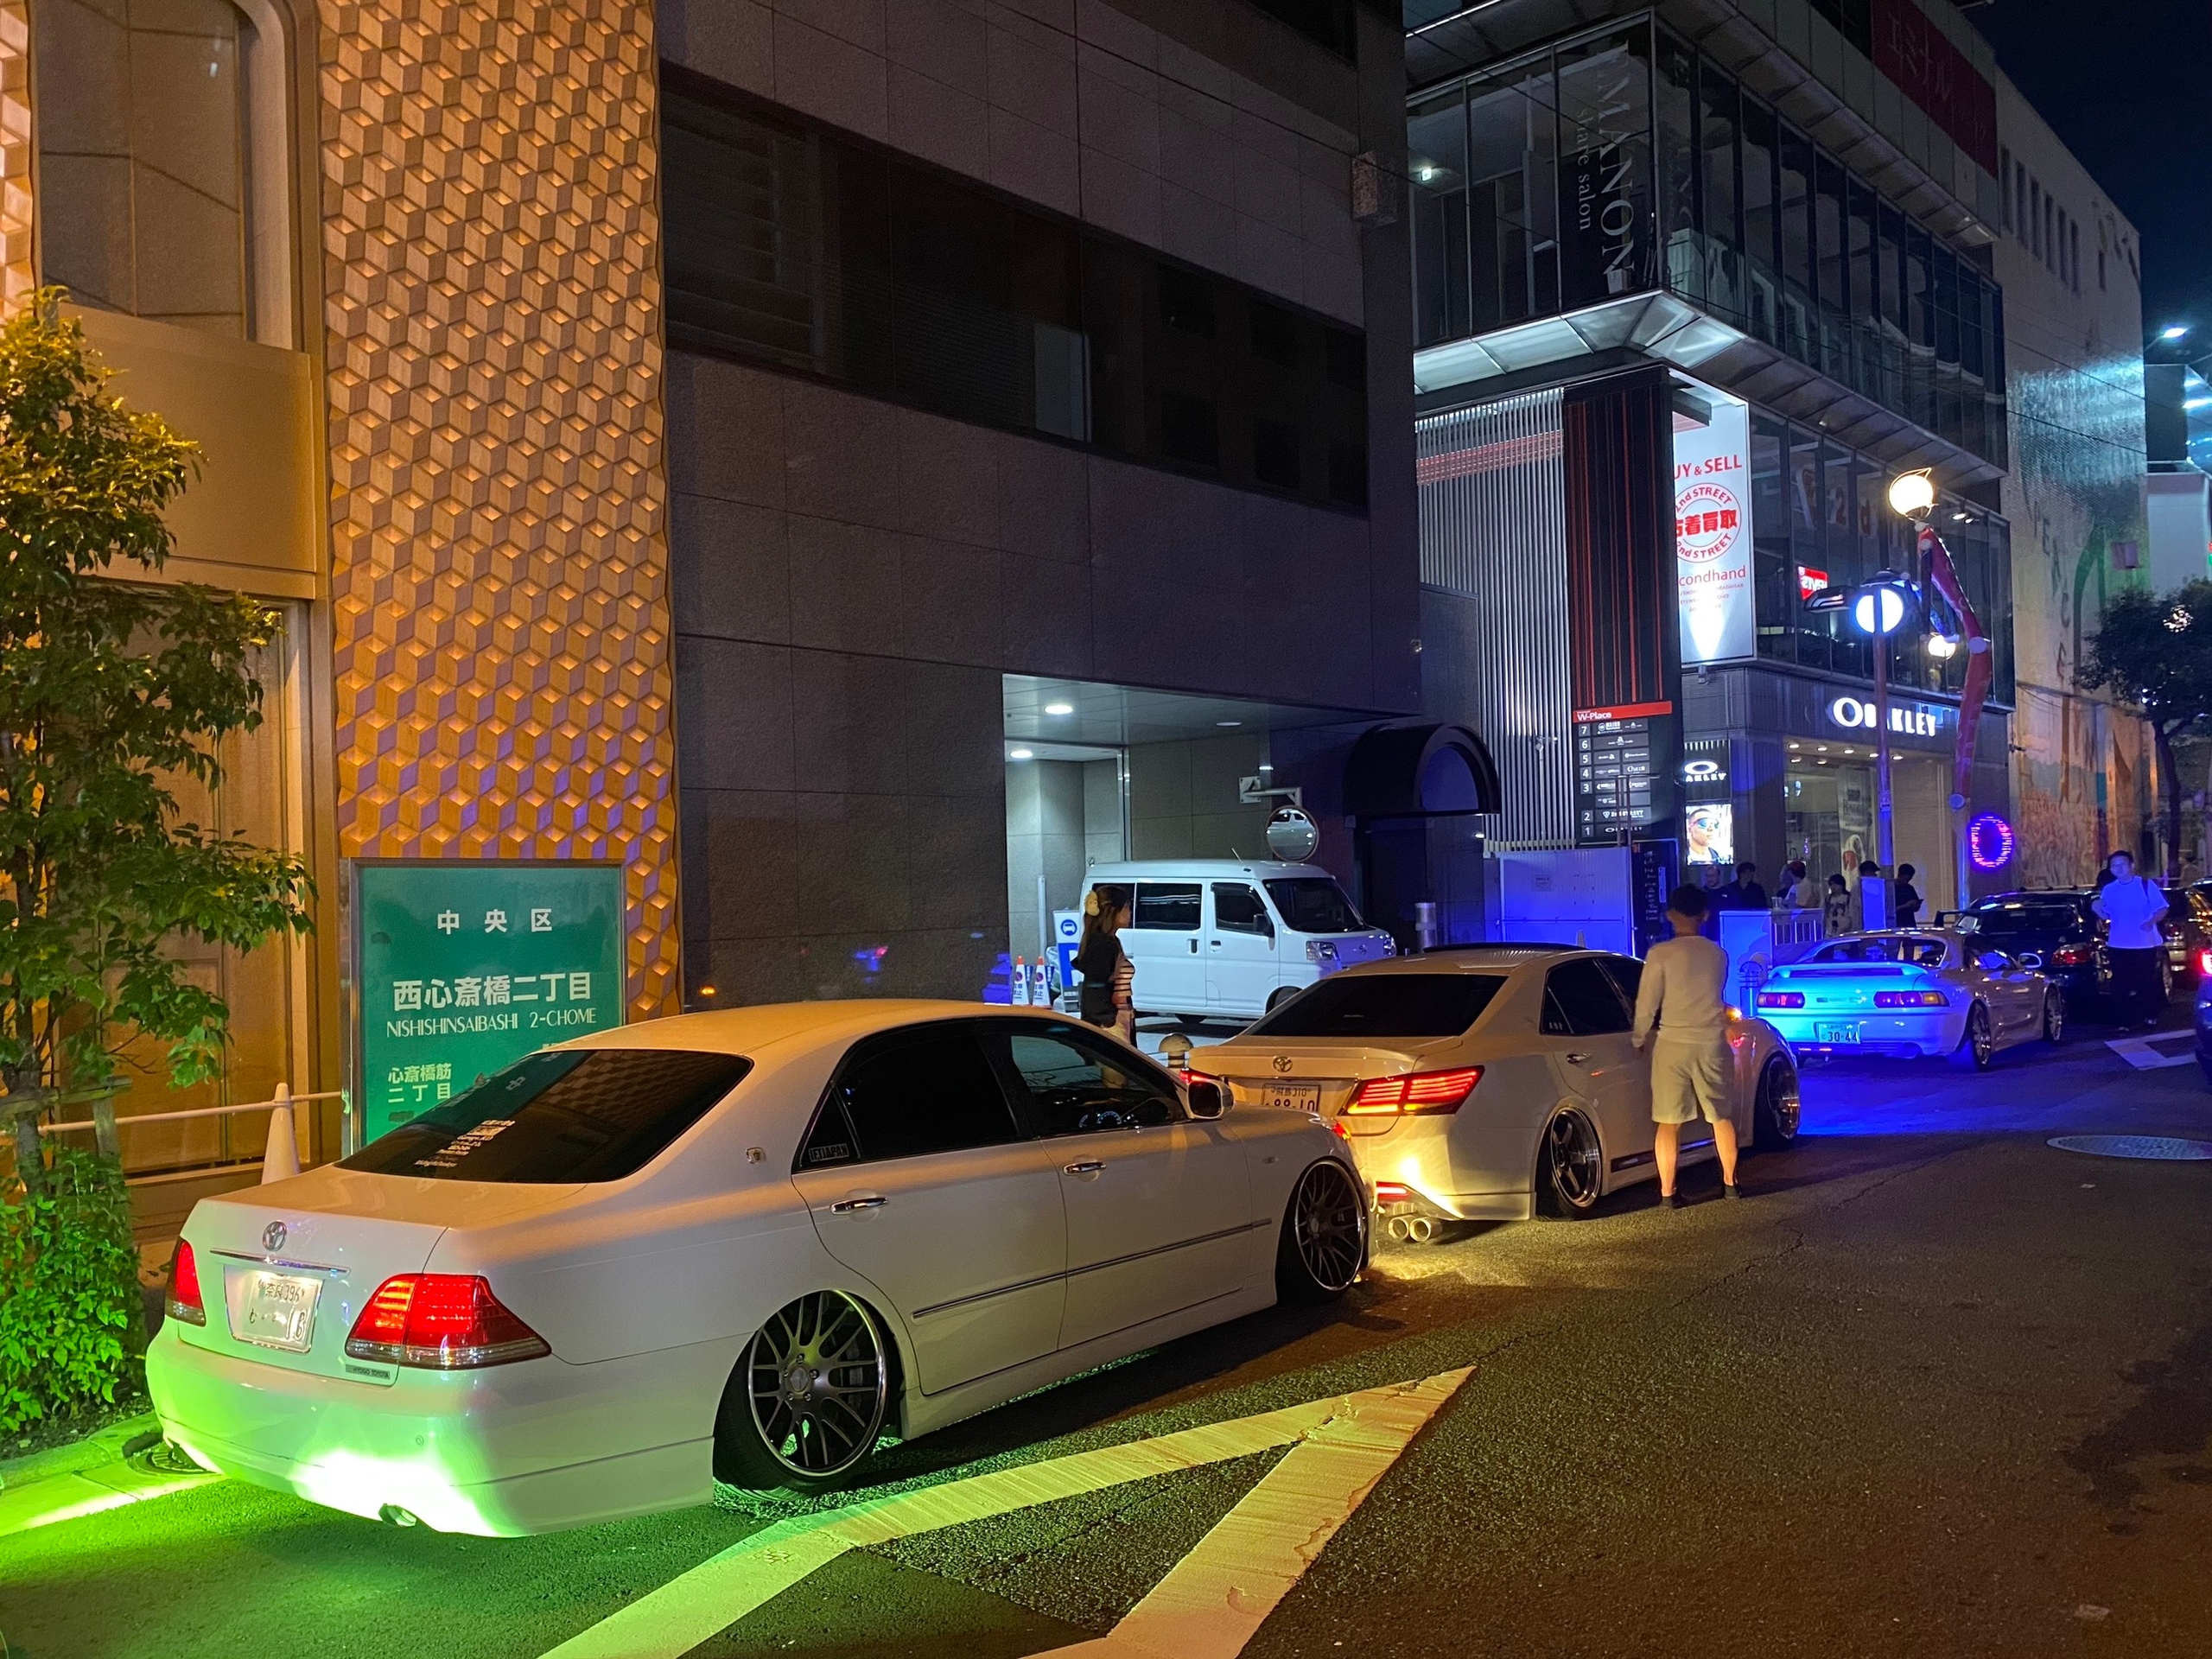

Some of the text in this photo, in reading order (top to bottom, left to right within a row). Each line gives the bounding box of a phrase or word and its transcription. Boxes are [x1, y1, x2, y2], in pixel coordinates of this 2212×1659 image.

[1576, 108, 1597, 231] share salon
[1599, 76, 1635, 276] MANON
[1694, 466, 1702, 476] &
[1704, 454, 1742, 474] SELL
[1693, 486, 1732, 505] STREET
[1693, 533, 1732, 559] STREET
[1577, 711, 1612, 721] W-Place
[1581, 726, 1587, 734] 7
[1581, 741, 1588, 749] 6
[1582, 754, 1588, 763] 5
[1582, 769, 1589, 778] 4
[1583, 784, 1589, 792] 3
[1584, 812, 1590, 821] 2
[1585, 827, 1590, 836] 1
[437, 908, 553, 936] 中央区
[392, 972, 592, 1012] 西心斎橋二丁目
[386, 1007, 597, 1039] NISHISHINSAIBASHI 2-CHOME
[1827, 1031, 1858, 1042] 30-44
[388, 1062, 452, 1084] 心斎橋筋
[388, 1082, 452, 1103] 二丁目
[371, 1370, 389, 1379] TOYOTA
